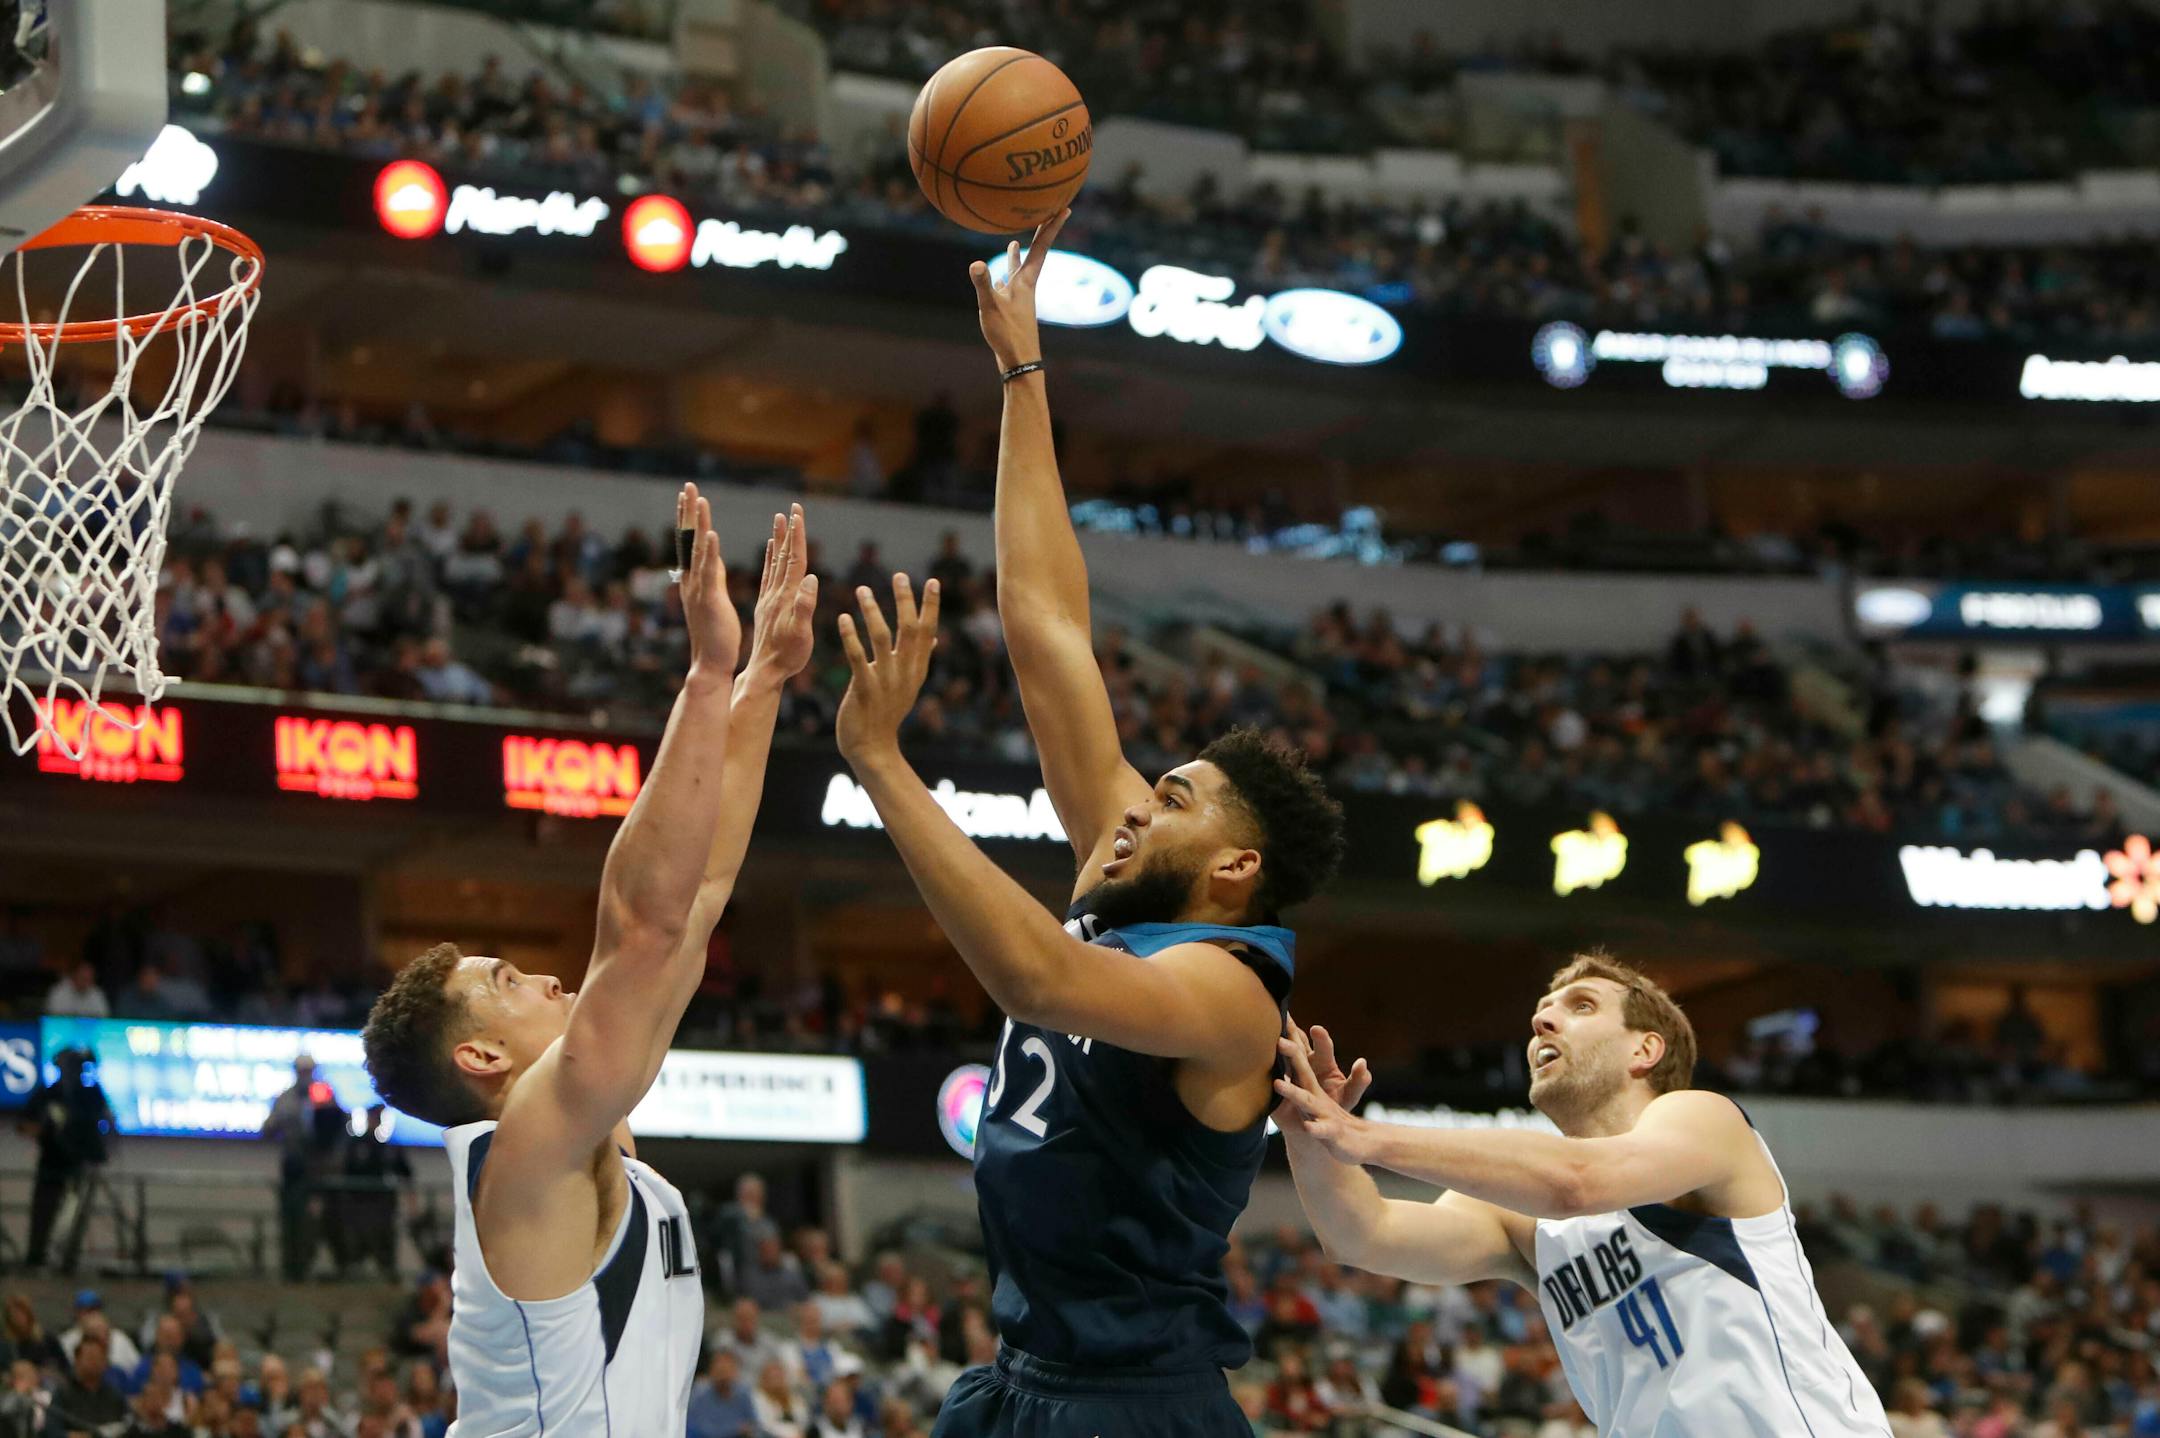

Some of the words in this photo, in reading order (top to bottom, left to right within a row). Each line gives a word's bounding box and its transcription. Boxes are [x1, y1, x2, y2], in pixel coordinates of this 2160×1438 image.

[1006, 124, 1092, 182] SPALDIN
[36, 697, 184, 764] IKON
[275, 716, 417, 783] IKON
[503, 734, 641, 799] IKON
[1615, 1276, 1685, 1371] 41
